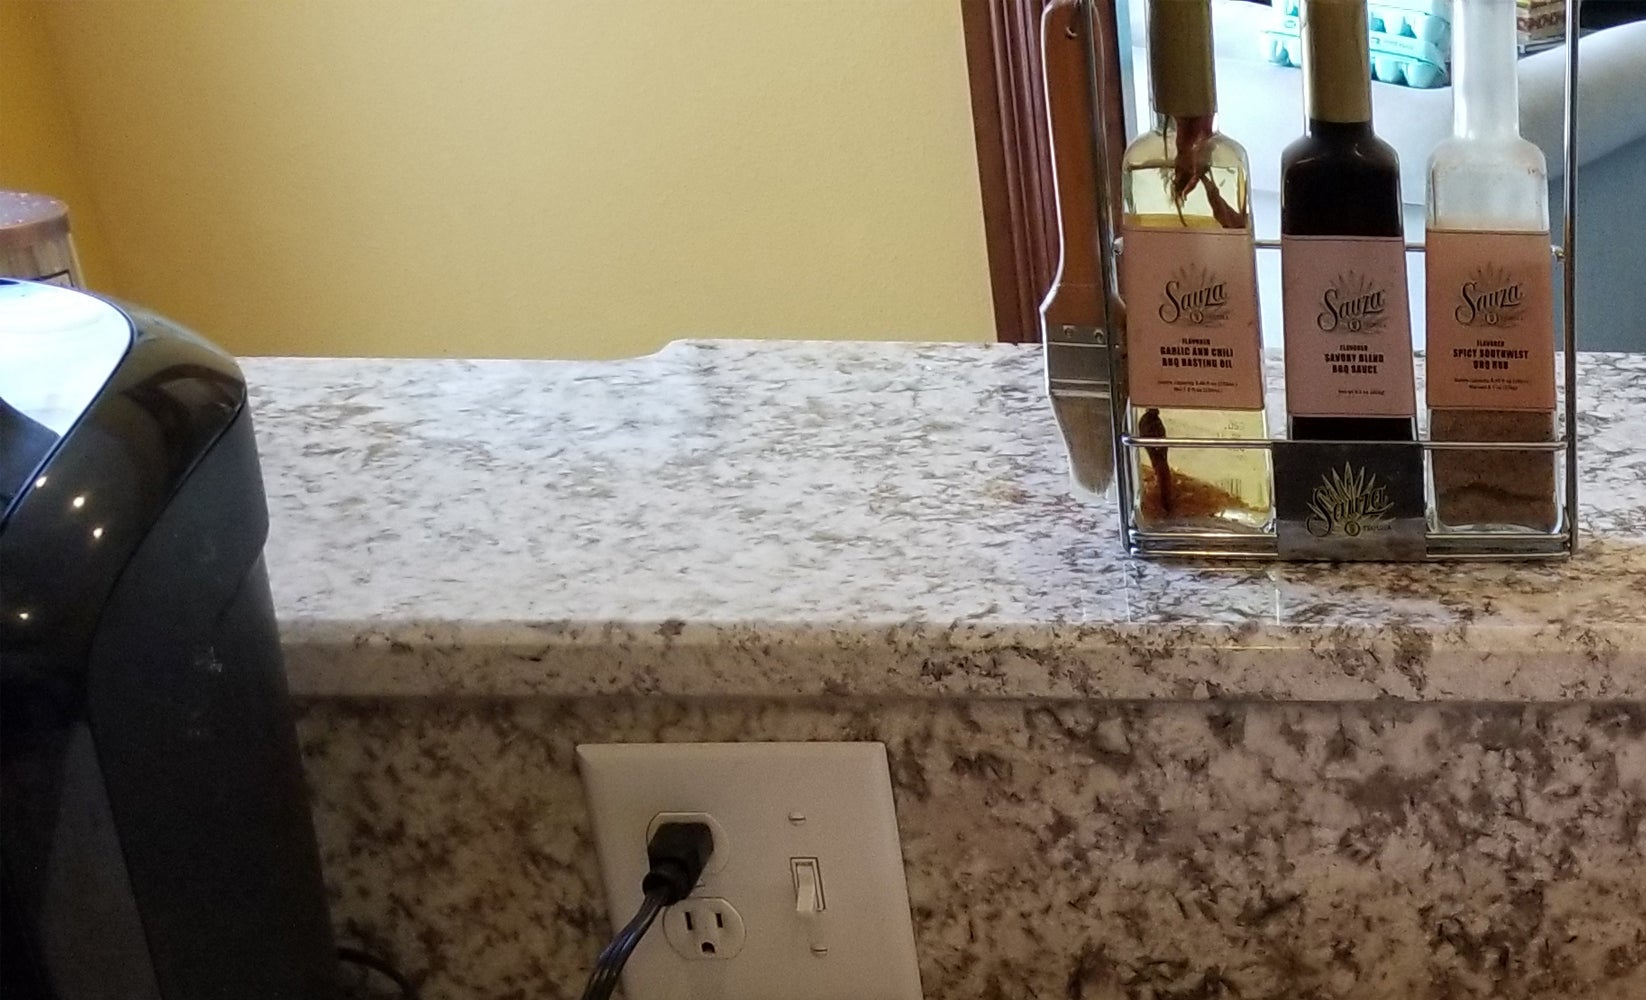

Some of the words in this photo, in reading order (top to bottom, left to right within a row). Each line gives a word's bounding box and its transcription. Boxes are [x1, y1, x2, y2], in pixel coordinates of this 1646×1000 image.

[1158, 280, 1228, 324] Sauza
[1455, 281, 1523, 326] Sauza
[1317, 288, 1386, 332] Sauza
[1160, 346, 1191, 357] GARLIC
[1192, 347, 1209, 357] AND
[1211, 348, 1234, 358] CHILI
[1324, 353, 1357, 363] SAVORY
[1358, 353, 1385, 363] BLEND
[1453, 348, 1478, 358] SPICY
[1479, 349, 1529, 360] SOUTHWEST
[1161, 357, 1180, 368] BBQ
[1181, 358, 1218, 368] BASTING
[1219, 358, 1233, 369] OIL
[1332, 364, 1350, 374] BBQ
[1350, 365, 1379, 374] SAUCE
[1306, 485, 1395, 538] Sauza
